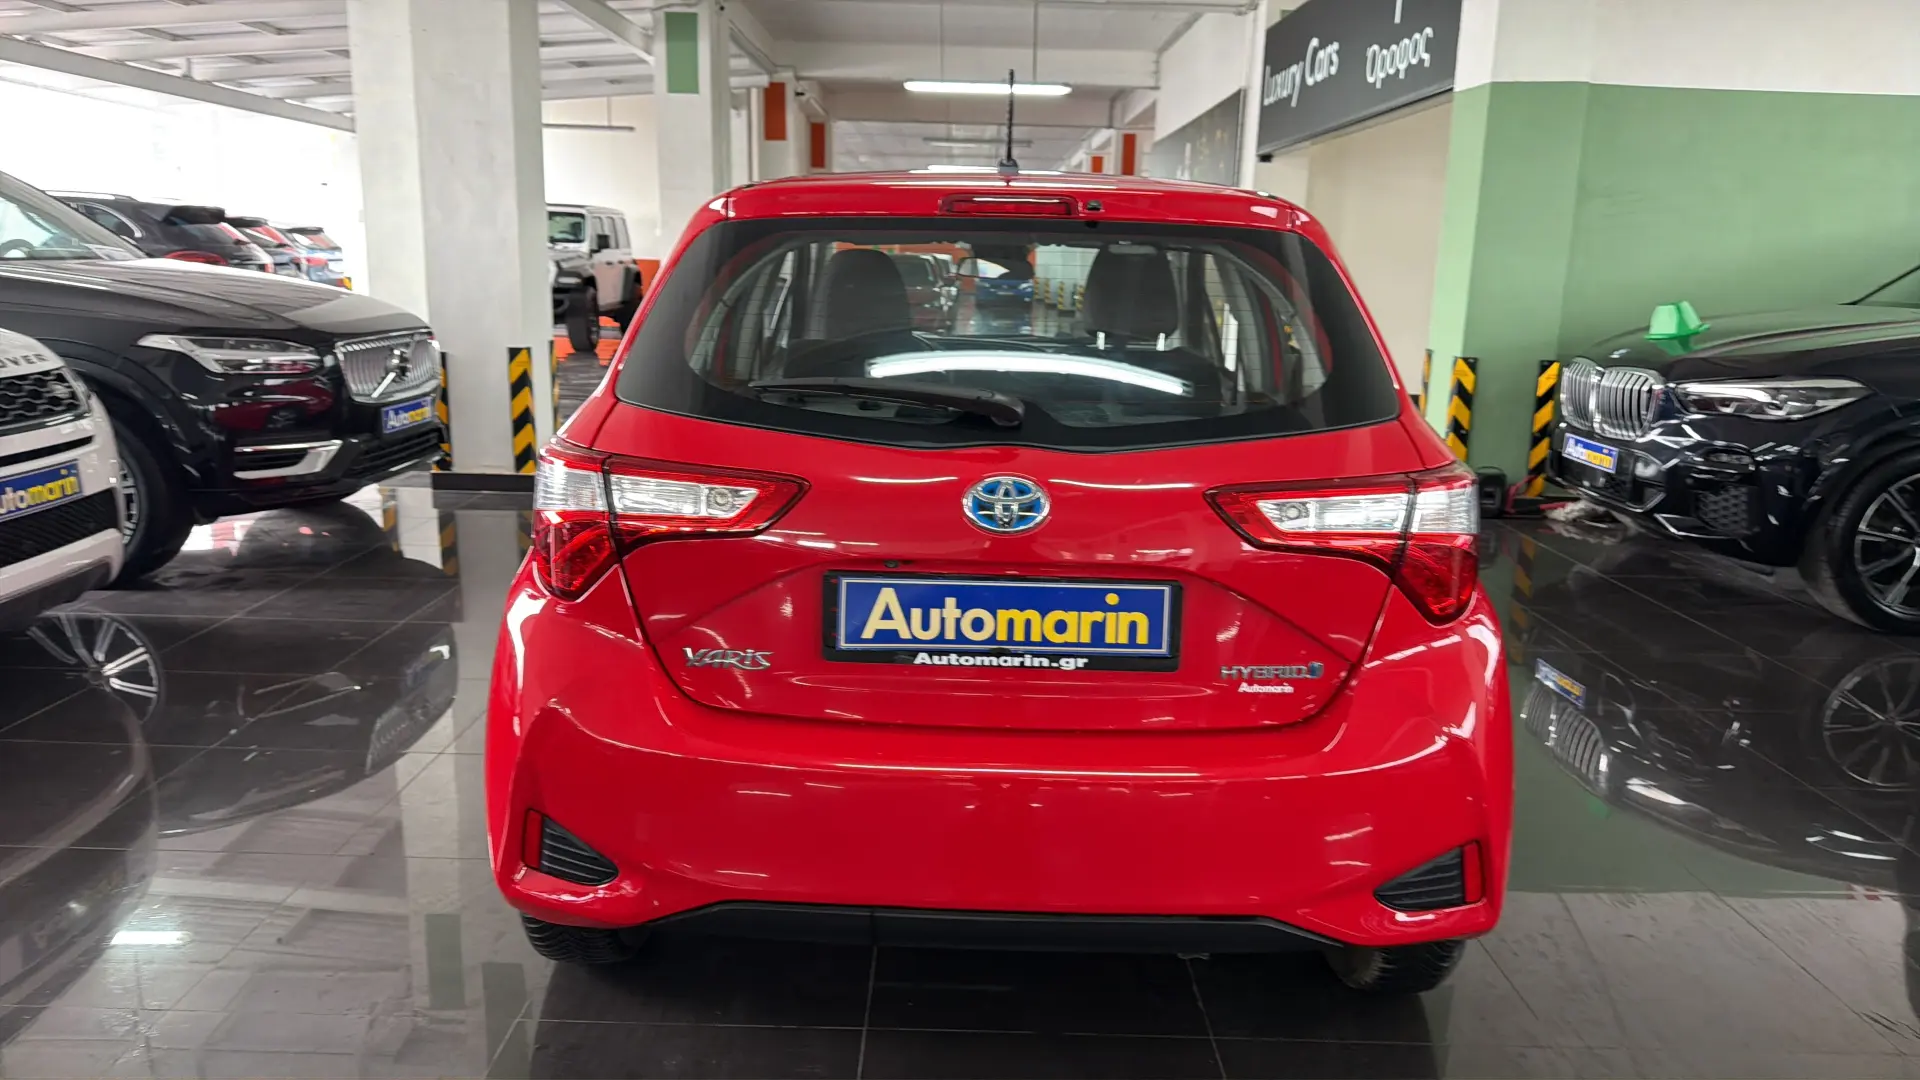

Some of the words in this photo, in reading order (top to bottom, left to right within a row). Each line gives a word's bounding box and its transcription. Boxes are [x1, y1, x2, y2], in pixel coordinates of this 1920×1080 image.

[1263, 61, 1304, 107] Luxury
[1305, 37, 1340, 86] Cars
[860, 587, 1149, 644] Automarin
[913, 652, 1088, 670] Automarin.gr
[1221, 665, 1307, 679] HYBRID
